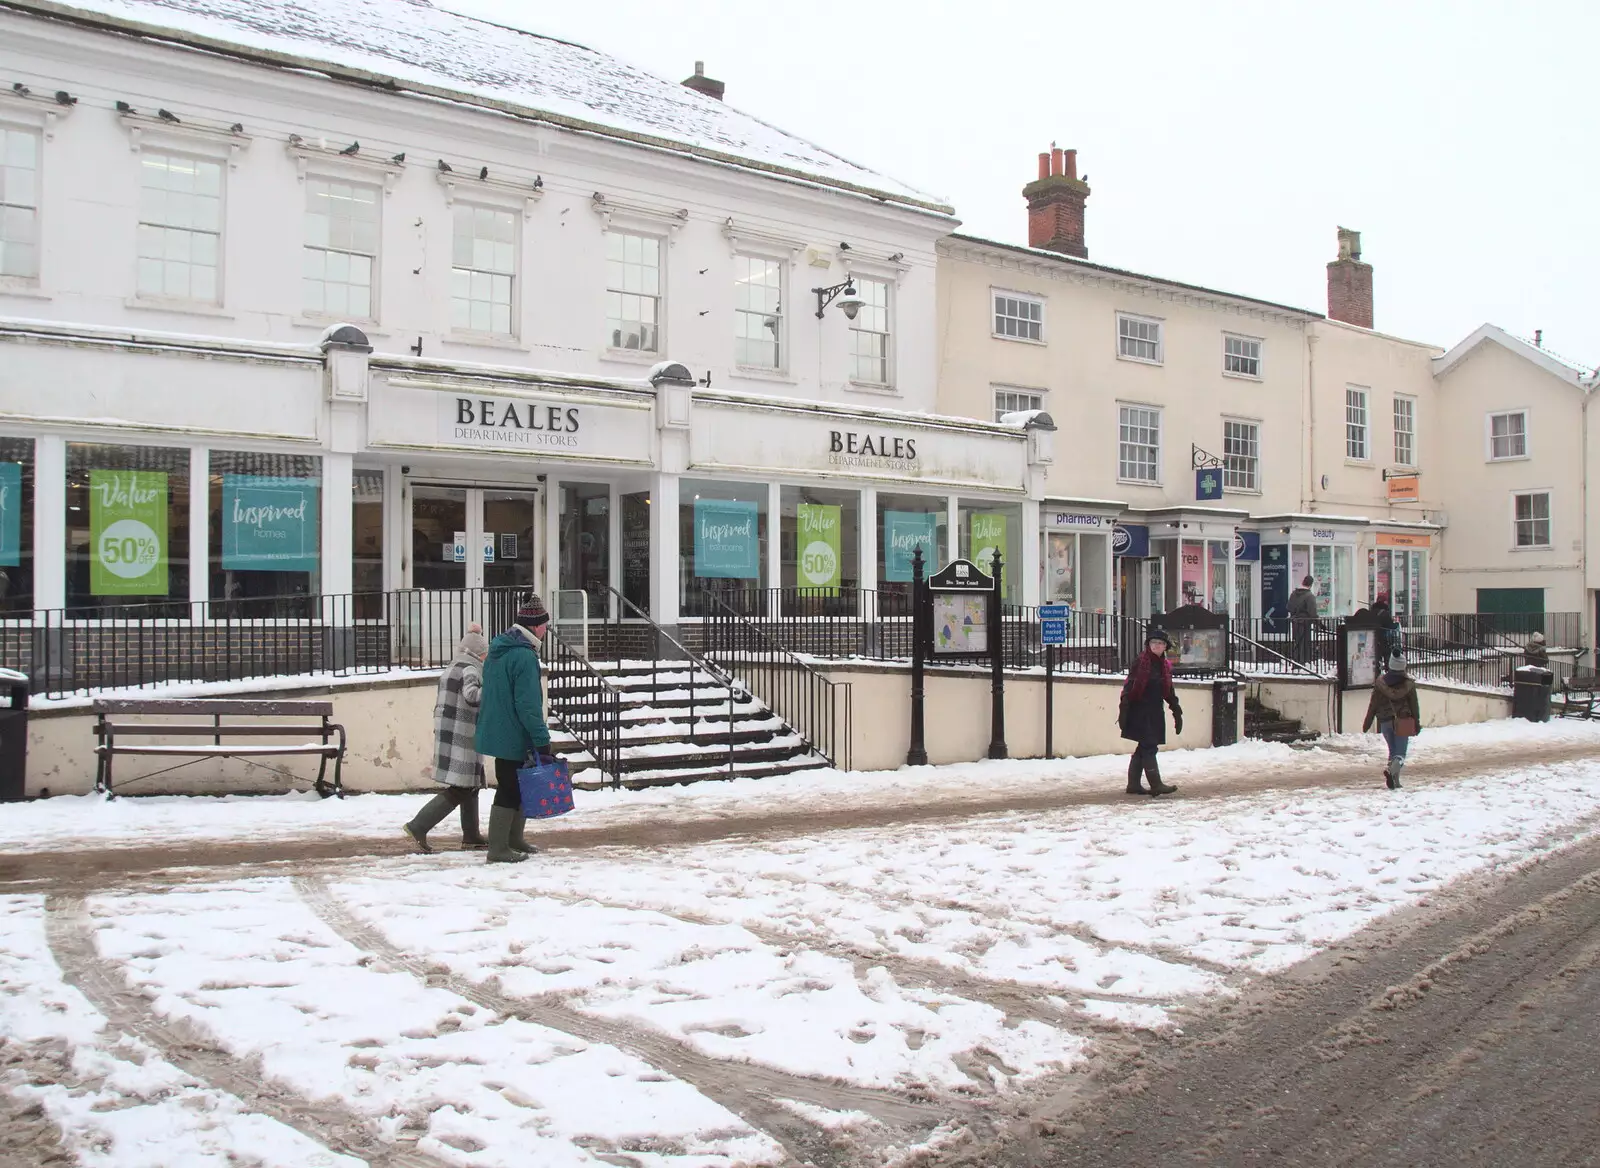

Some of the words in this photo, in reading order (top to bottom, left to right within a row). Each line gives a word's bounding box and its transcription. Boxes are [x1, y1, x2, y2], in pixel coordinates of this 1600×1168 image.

[456, 398, 579, 433] BEALES
[454, 427, 532, 444] DEPARTMENT
[537, 433, 578, 447] STORES
[829, 430, 916, 460] BEALES
[828, 455, 881, 468] DEPARTMENT
[886, 460, 916, 471] STORES
[95, 475, 158, 509] Value
[232, 498, 308, 529] Inspired
[799, 507, 835, 533] Value
[1056, 512, 1102, 527] pharmacy
[253, 528, 287, 539] homes
[700, 517, 751, 542] Inspired
[891, 528, 932, 550] Inspired
[973, 517, 1002, 542] Value
[1313, 528, 1335, 540] beauty
[103, 537, 155, 564] 50%
[138, 554, 155, 565] OFF
[804, 553, 833, 573] 50%
